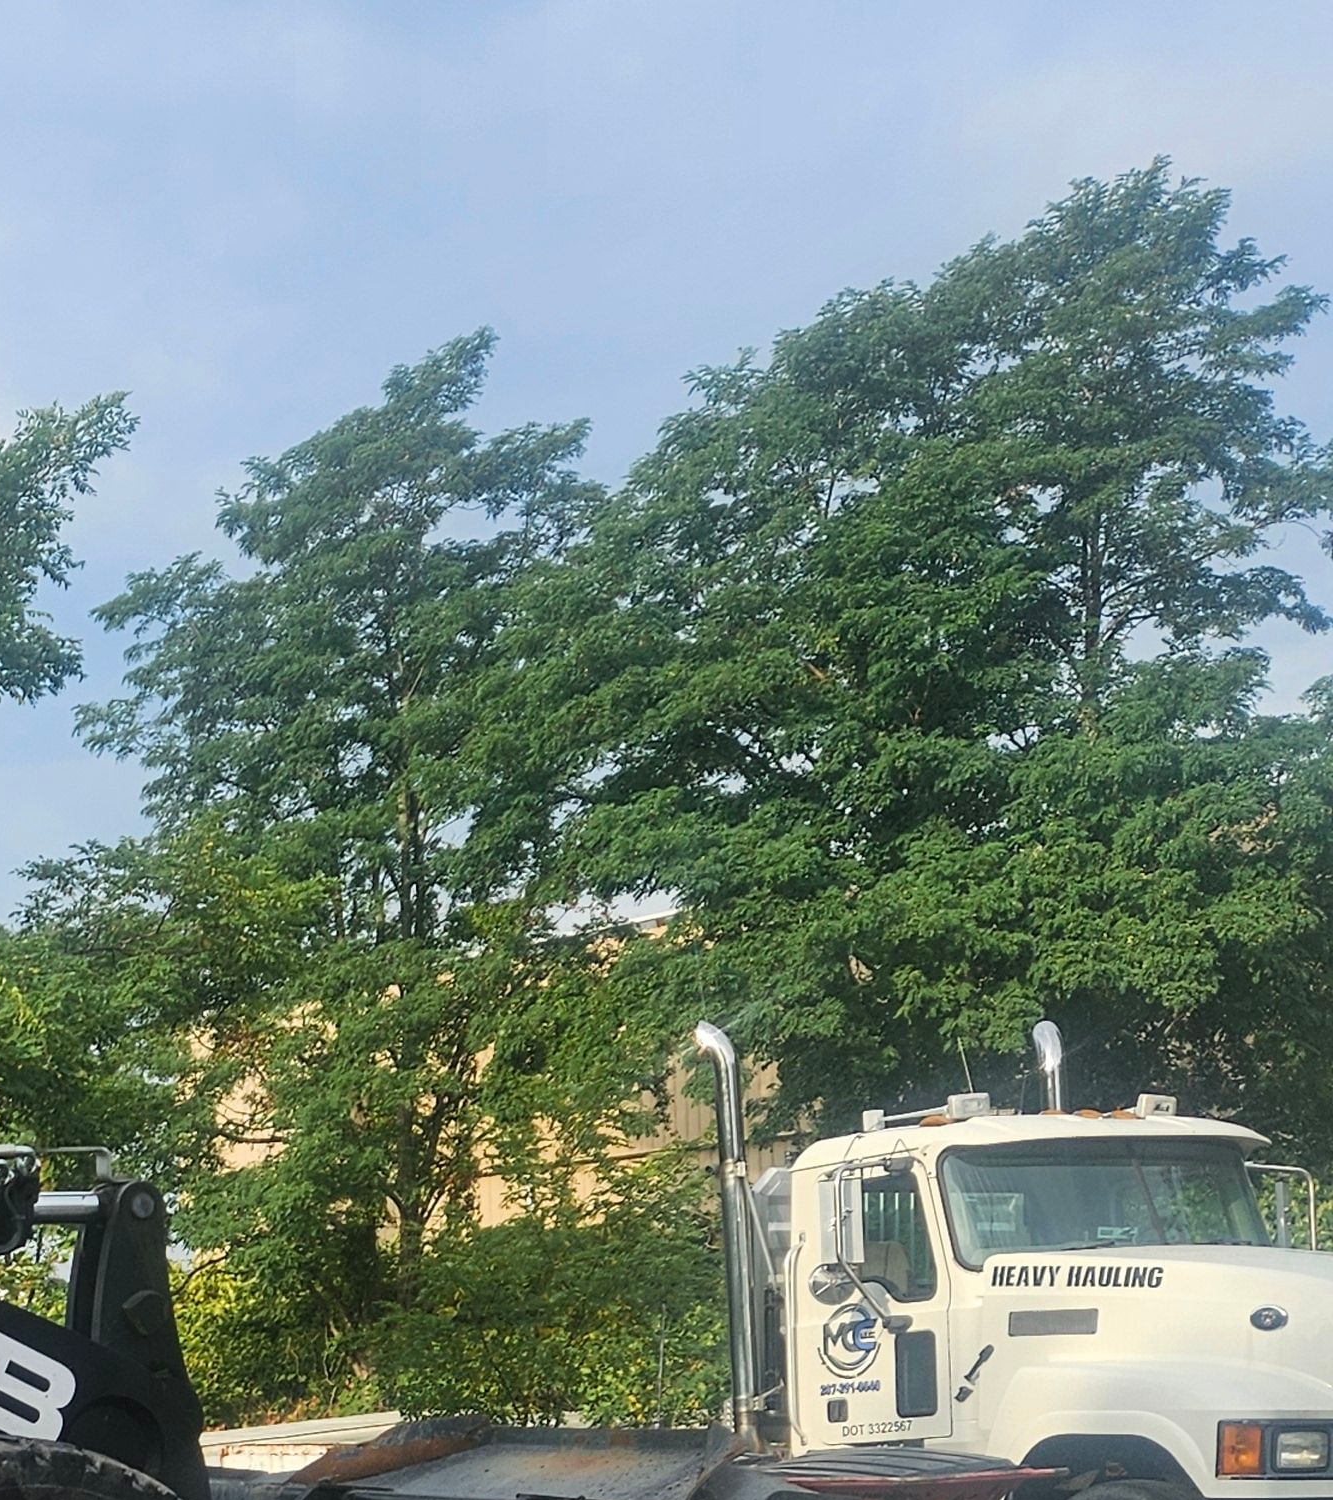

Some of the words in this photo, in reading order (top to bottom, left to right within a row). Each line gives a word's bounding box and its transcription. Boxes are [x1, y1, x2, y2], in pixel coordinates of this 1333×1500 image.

[991, 1265, 1061, 1287] HEAVY
[1066, 1265, 1164, 1289] HAULING
[823, 1318, 879, 1353] MCC
[842, 1424, 865, 1437] DOT
